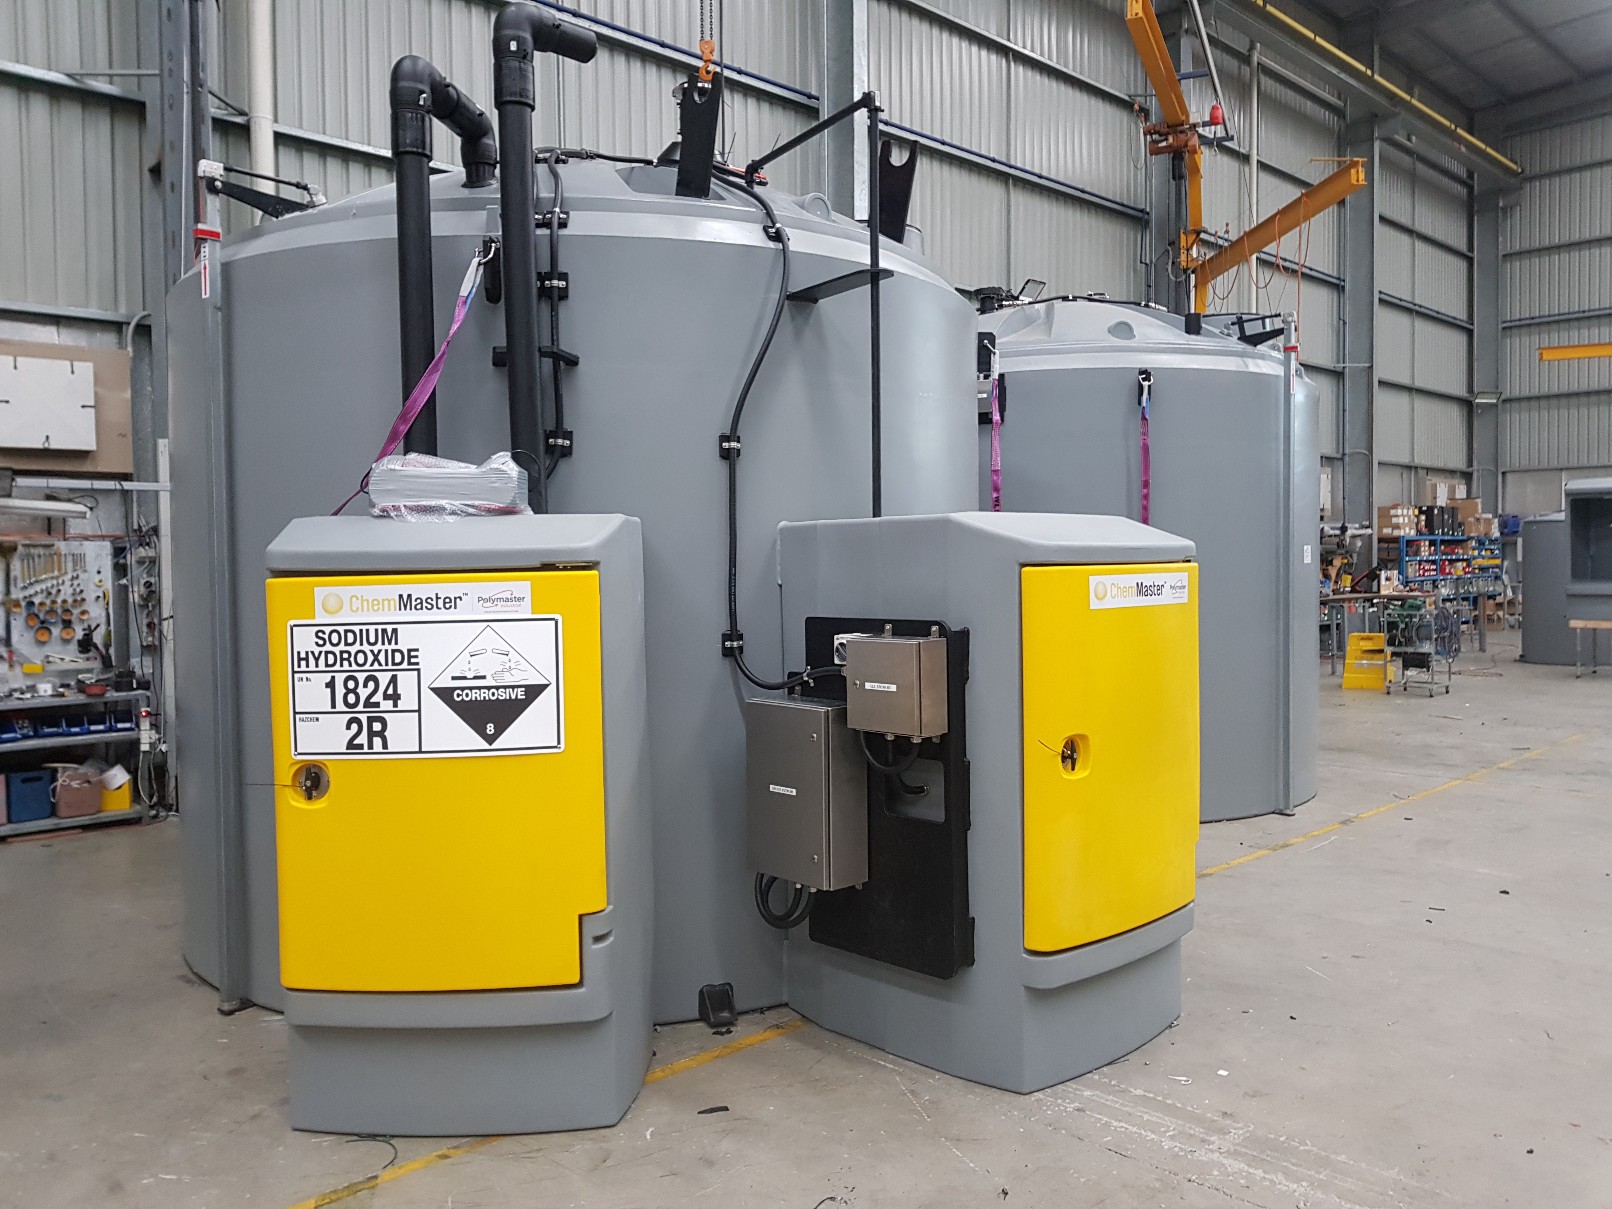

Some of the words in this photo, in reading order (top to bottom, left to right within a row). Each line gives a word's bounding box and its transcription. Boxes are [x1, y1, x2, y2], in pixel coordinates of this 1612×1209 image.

[477, 595, 526, 605] Polymaster
[314, 627, 399, 648] SODIUM
[296, 648, 420, 669] HYDROXIDE
[324, 673, 402, 710] 1824
[453, 687, 526, 702] CORROSIVE
[345, 715, 389, 751] 2R
[486, 723, 495, 735] 8
